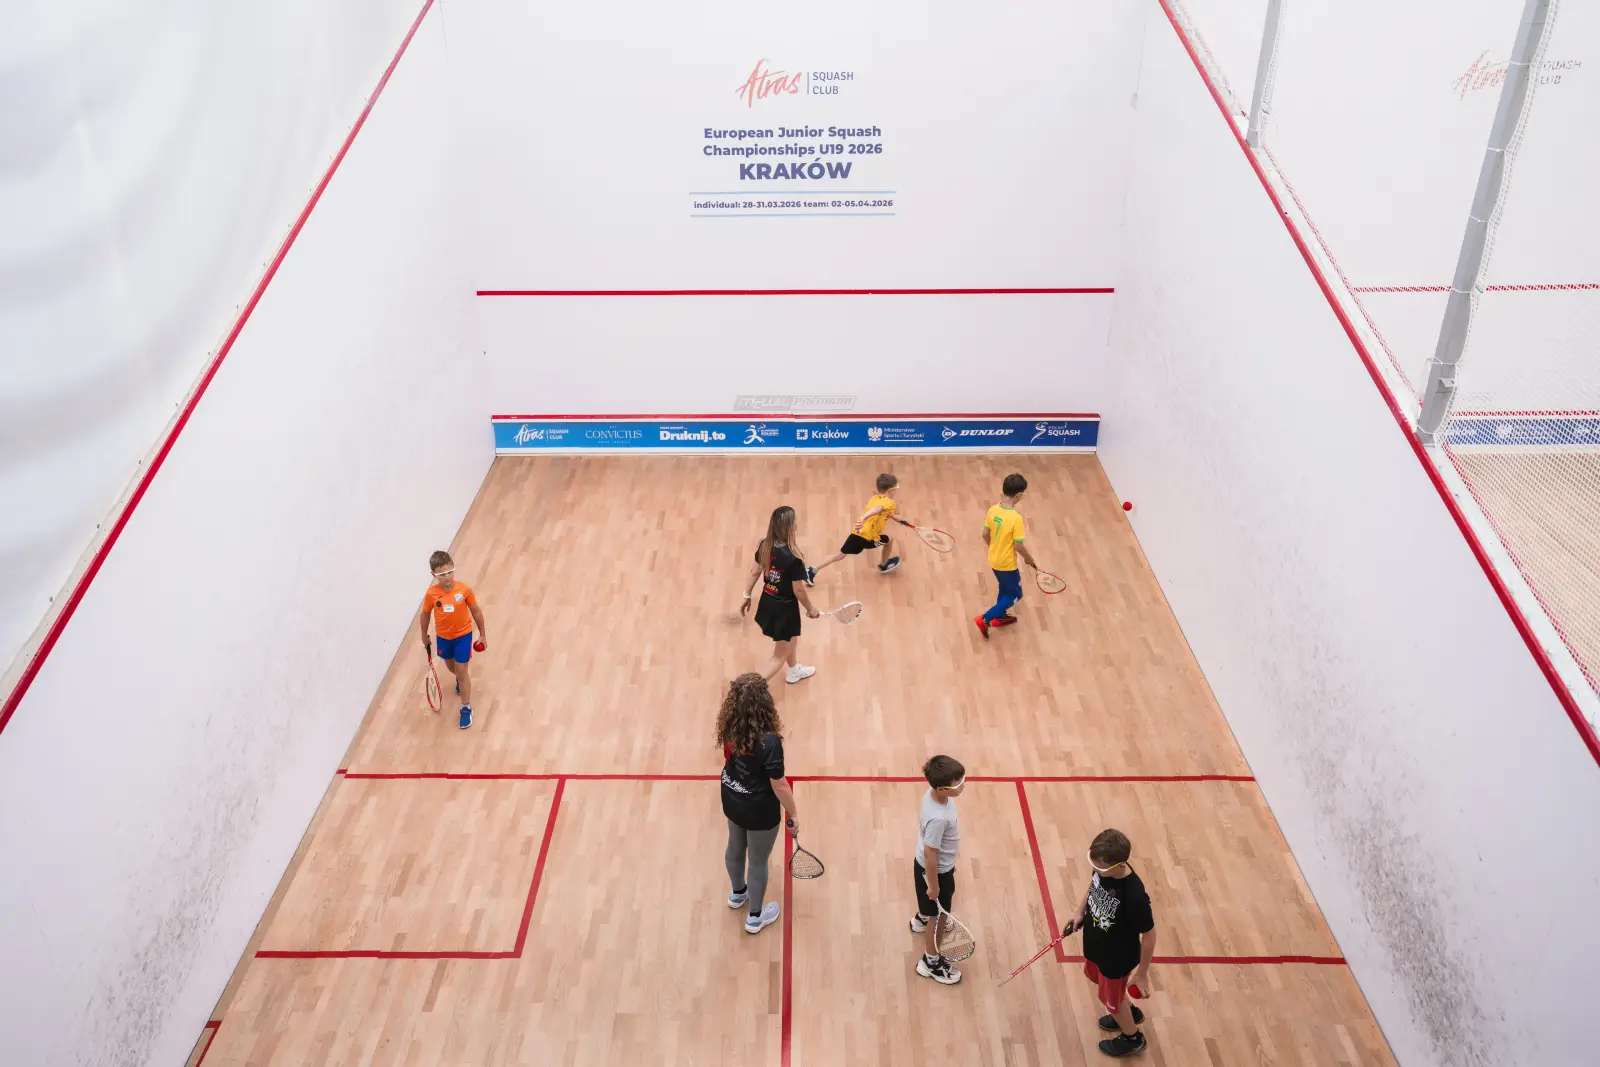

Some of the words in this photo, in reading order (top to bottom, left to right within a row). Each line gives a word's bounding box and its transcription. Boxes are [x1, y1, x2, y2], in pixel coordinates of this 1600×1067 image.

[813, 71, 854, 81] SQUASH
[1450, 48, 1508, 101] Atra
[735, 58, 802, 108] Atras
[813, 85, 839, 95] CLUB
[704, 127, 774, 140] European
[778, 125, 824, 138] Junior
[828, 125, 881, 139] Squash
[703, 143, 815, 158] Championships
[819, 143, 844, 155] U19
[848, 143, 883, 154] 2026
[739, 158, 852, 180] KRAKÓW
[694, 201, 741, 209] individual:
[803, 200, 829, 208] team:
[513, 424, 545, 446] Atras
[585, 430, 643, 439] CONVICTUS
[659, 430, 726, 442] Druknij.to
[811, 429, 849, 439] Kraków
[993, 516, 1003, 540] 7
